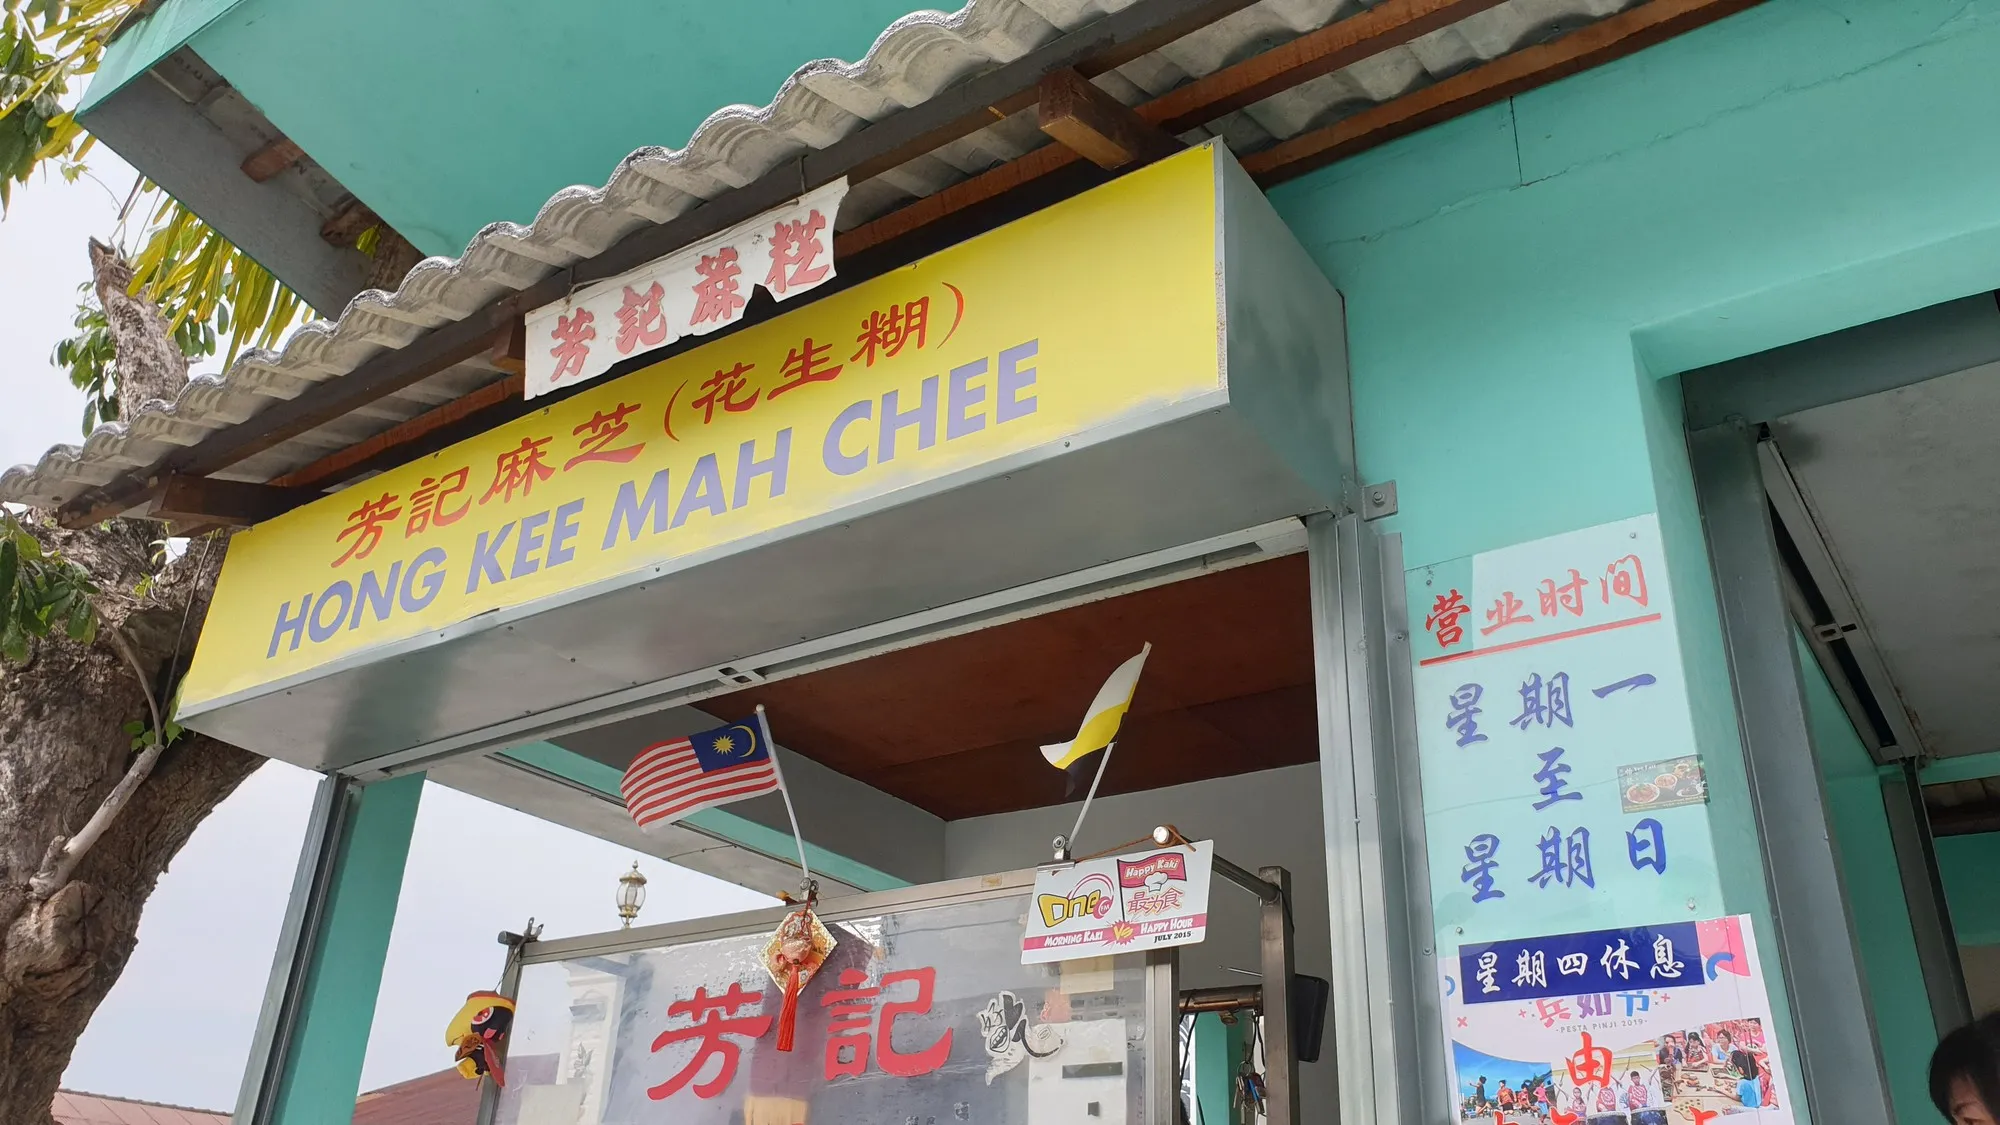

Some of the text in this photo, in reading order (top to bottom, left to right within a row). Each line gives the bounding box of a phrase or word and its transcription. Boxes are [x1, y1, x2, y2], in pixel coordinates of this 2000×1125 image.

[266, 338, 1039, 659] HONG KEE MAH CHEE
[1425, 553, 1649, 649] 营业时间
[1445, 671, 1657, 748] 星期一
[1531, 746, 1583, 812] 至
[1125, 858, 1181, 879] Happy Kaki
[1460, 817, 1667, 904] 星期日
[1127, 887, 1184, 914] 最为食
[1154, 930, 1192, 943] JULY 2015
[1475, 934, 1685, 995] 星期四休息
[647, 966, 953, 1101] 芳記
[1565, 1031, 1613, 1088] 由
